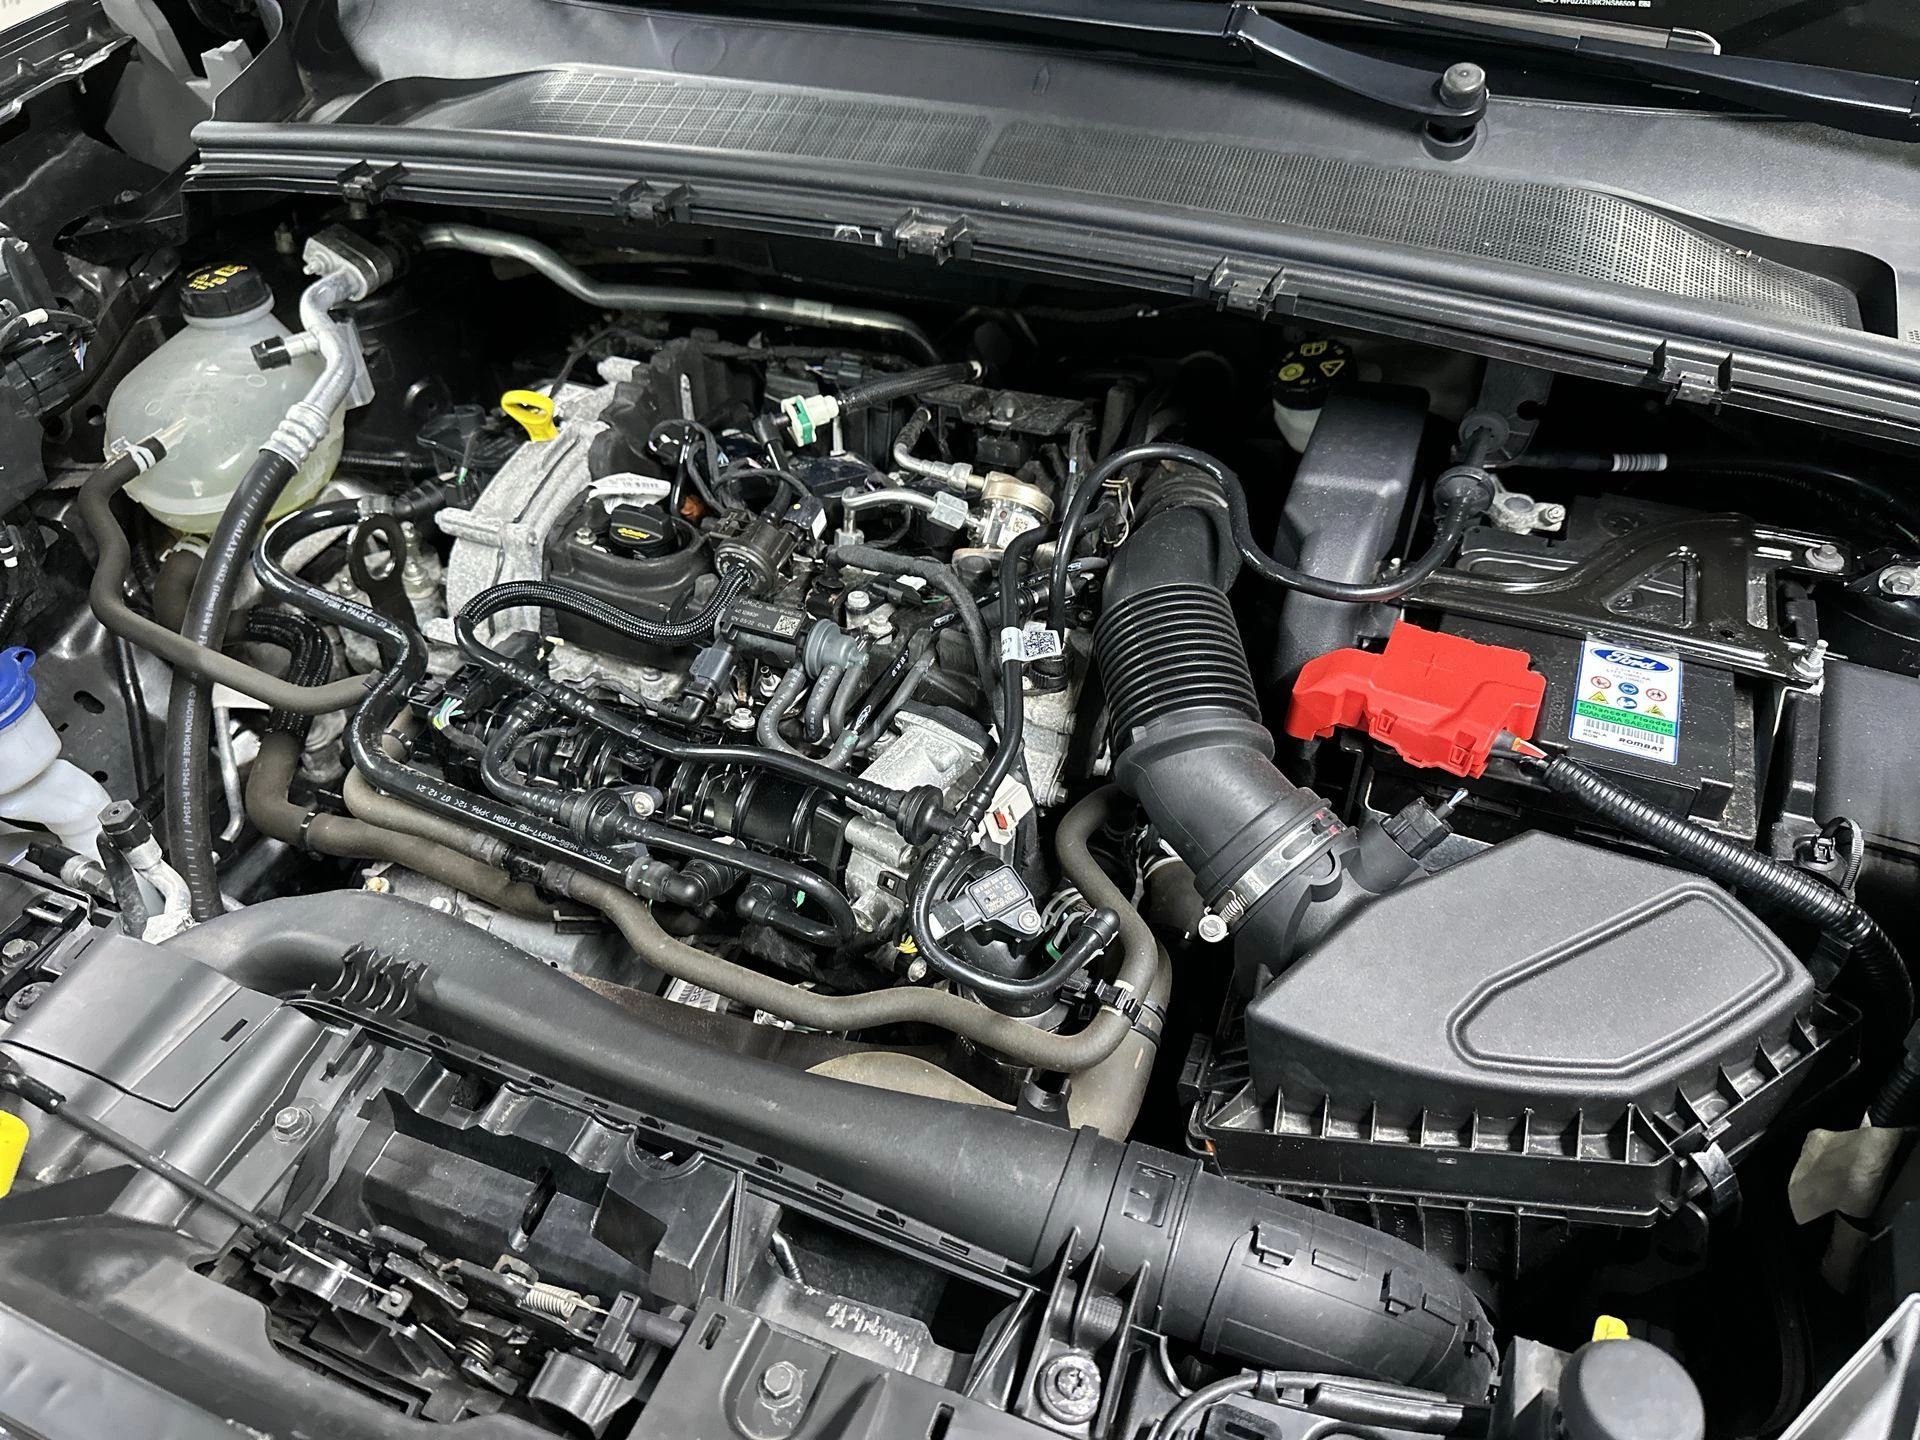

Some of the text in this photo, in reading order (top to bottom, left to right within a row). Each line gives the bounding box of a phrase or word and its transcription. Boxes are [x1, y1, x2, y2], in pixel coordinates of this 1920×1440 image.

[226, 518, 247, 561] GALAXY
[1605, 650, 1657, 670] Ford
[184, 698, 195, 733] SUCTION
[1580, 703, 1673, 729] Enhanced Flooded
[183, 734, 192, 755] HOSE
[1618, 737, 1664, 752] ROMBAT
[582, 848, 612, 864] FoMoCo
